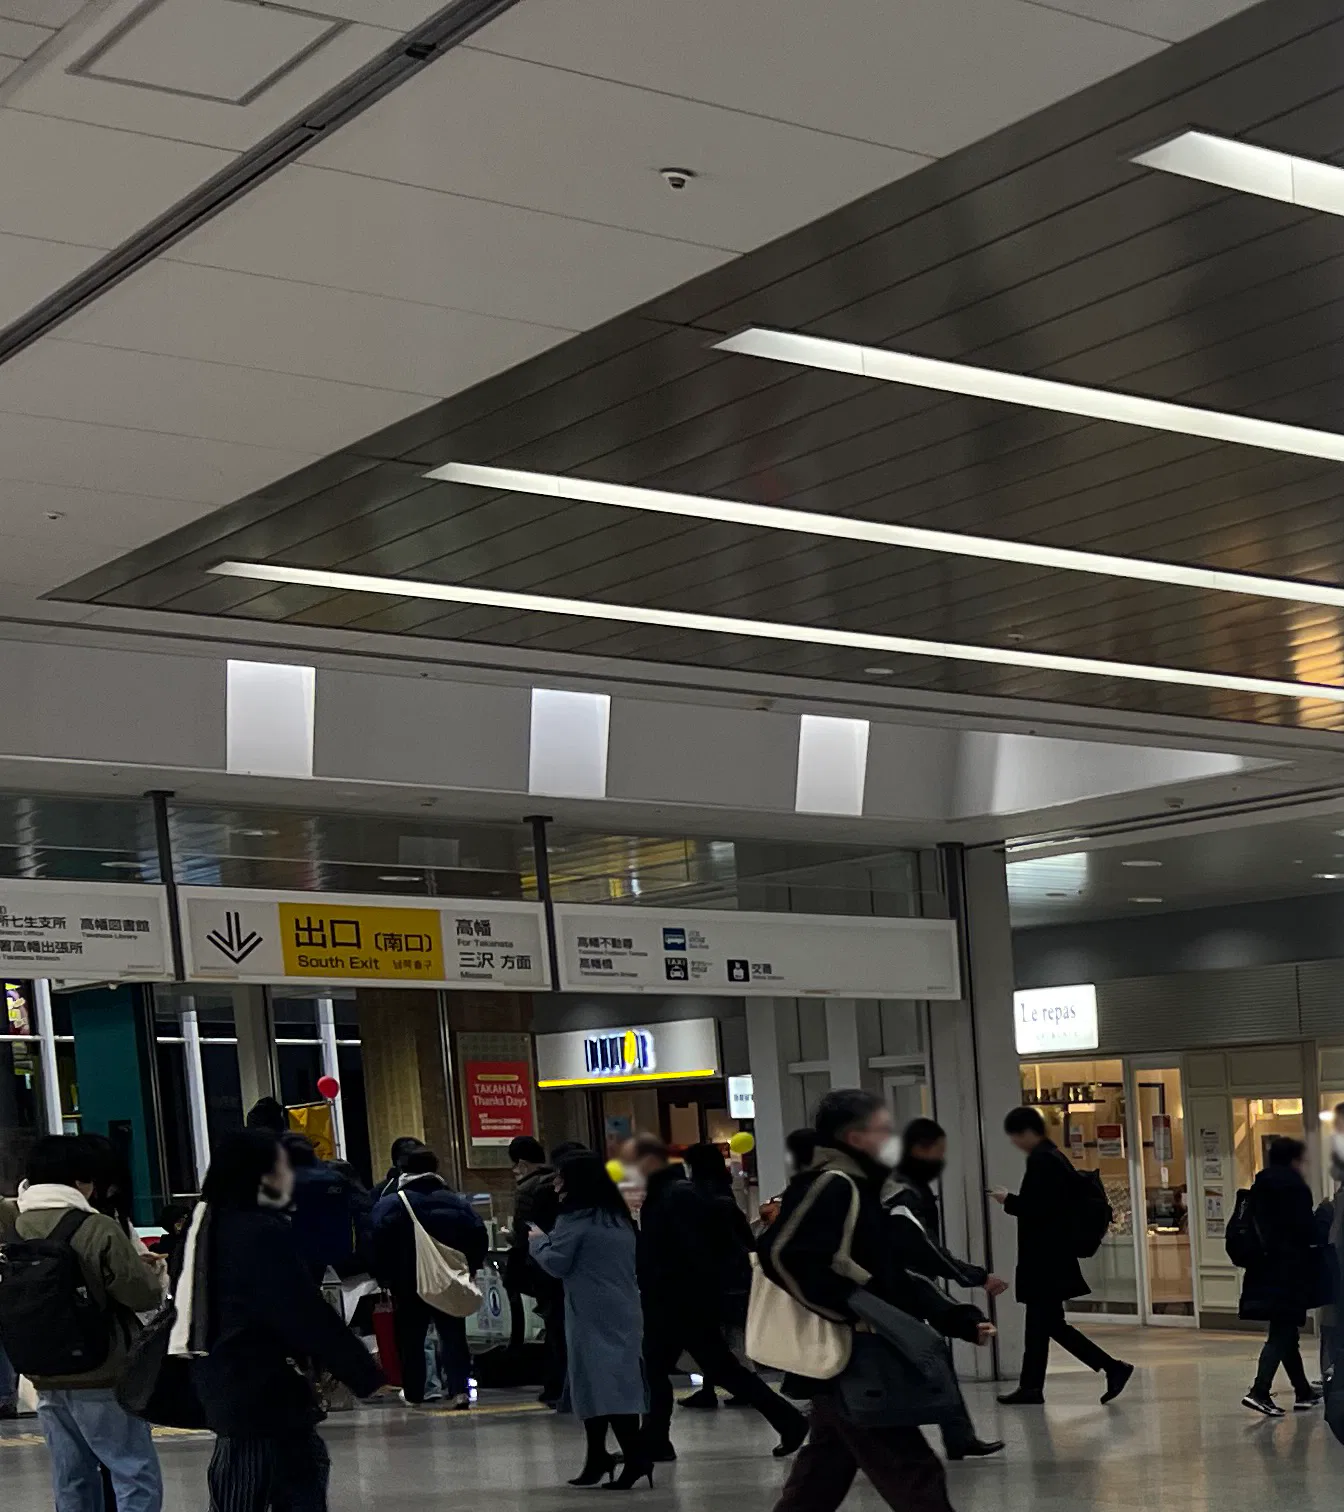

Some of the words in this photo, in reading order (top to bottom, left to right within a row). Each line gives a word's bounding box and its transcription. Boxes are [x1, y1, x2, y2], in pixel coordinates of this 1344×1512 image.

[294, 916, 362, 949] 出口
[455, 918, 491, 937] 高幡
[298, 955, 345, 970] South
[350, 956, 380, 970] Exit
[459, 951, 495, 969] 三沢
[501, 954, 532, 970] 方面
[1021, 1003, 1037, 1022] Le
[1042, 1005, 1076, 1025] repas
[474, 1083, 524, 1094] TAKAHATA
[473, 1095, 504, 1106] Thanks
[506, 1096, 528, 1108] Days
